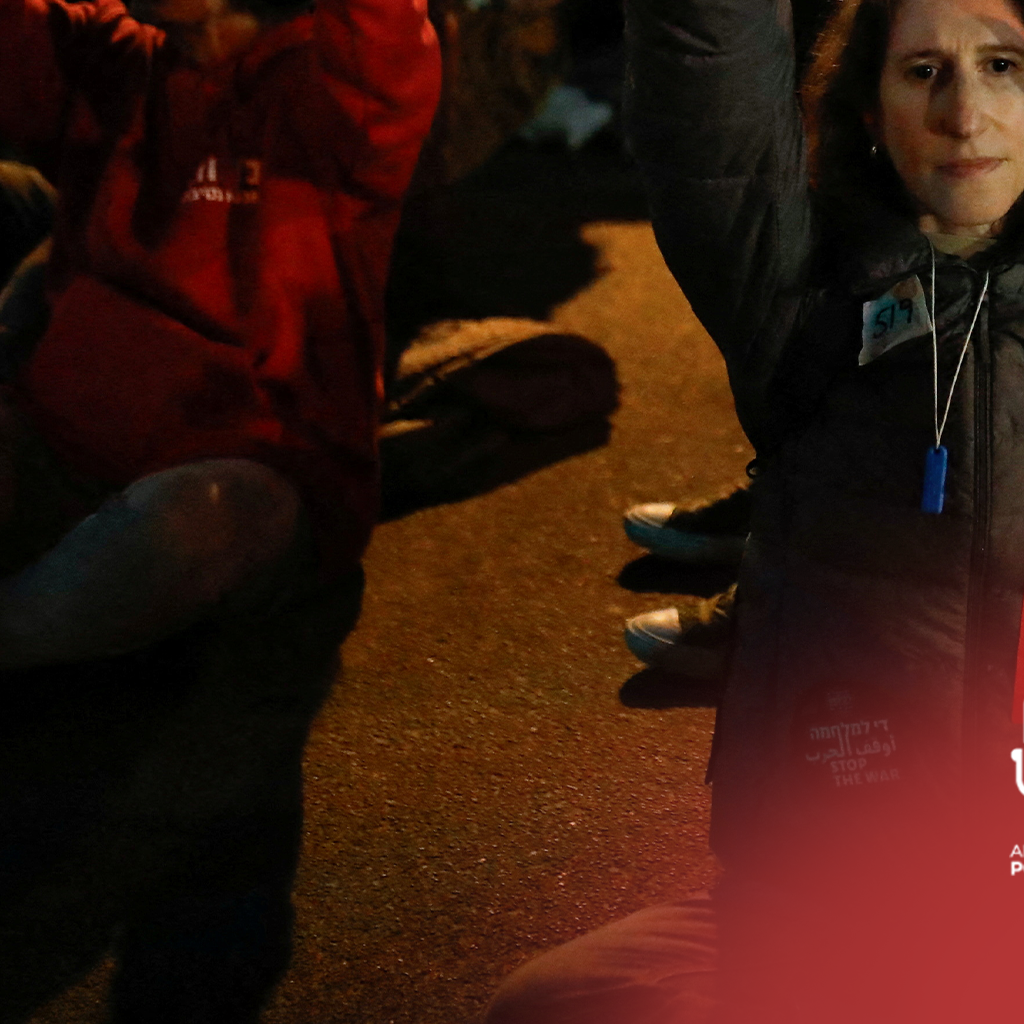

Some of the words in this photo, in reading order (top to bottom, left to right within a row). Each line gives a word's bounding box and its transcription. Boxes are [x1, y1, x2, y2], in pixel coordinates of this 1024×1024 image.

[830, 758, 867, 774] STOP
[832, 771, 863, 788] THE
[864, 768, 901, 784] WAR
